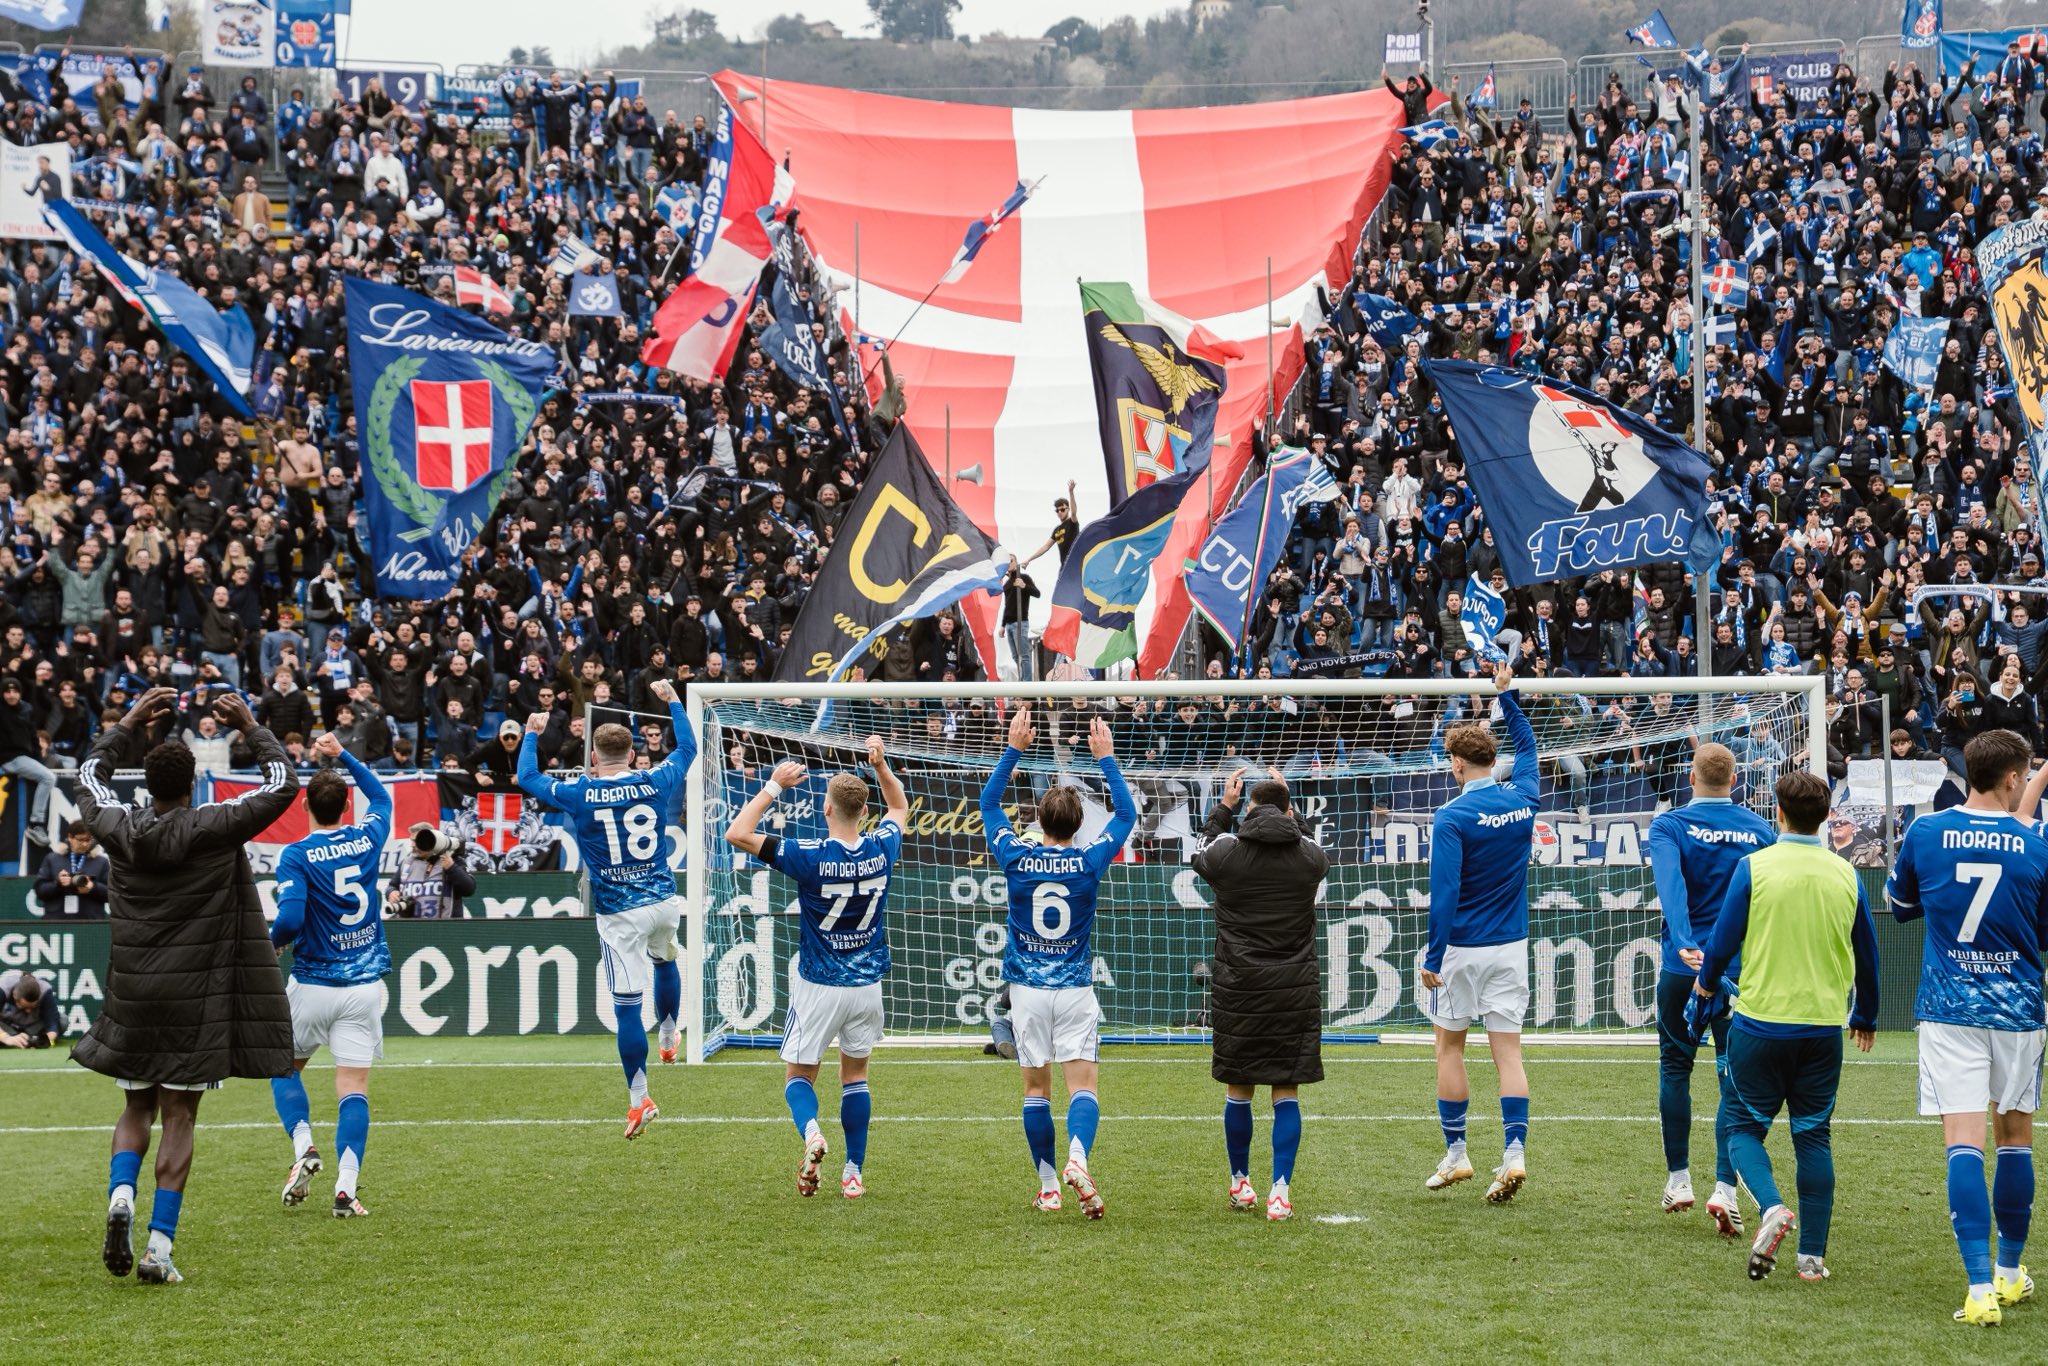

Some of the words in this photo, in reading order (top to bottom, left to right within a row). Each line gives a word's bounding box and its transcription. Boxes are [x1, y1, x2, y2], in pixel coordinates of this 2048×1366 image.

[1386, 33, 1420, 48] PODI
[1386, 49, 1420, 63] MINGA
[1786, 63, 1831, 79] CLUB
[444, 78, 515, 93] LOMAZO
[716, 105, 731, 144] 25
[691, 157, 729, 269] MAGGIO
[1349, 653, 1376, 664] ZERO
[585, 785, 638, 803] ALBERTO
[1491, 806, 1533, 828] OPTIMA
[594, 804, 658, 865] 18
[1701, 829, 1758, 845] OPTIMA
[1943, 829, 2025, 855] MORATA
[306, 835, 374, 863] GOLDANIGA
[600, 862, 656, 877] NEUBERGER
[819, 862, 838, 877] VAN
[840, 862, 857, 877] DER
[1017, 856, 1084, 874] CAQUERET
[611, 871, 649, 882] BERMAN
[334, 865, 369, 925] 5
[818, 874, 888, 931] 77
[1956, 862, 2003, 943] 7
[1032, 881, 1071, 940] 6
[330, 922, 377, 942] NEUBERGER
[821, 926, 878, 941] NEUBERGER
[1019, 932, 1078, 945] NEUBERGER
[0, 933, 75, 965] GNI
[340, 936, 375, 951] BERMAN
[832, 938, 871, 950] BERMAN
[1027, 943, 1069, 955] BERMAN
[1947, 949, 2021, 962] NEUBERGER
[1960, 963, 2012, 974] BERMAN
